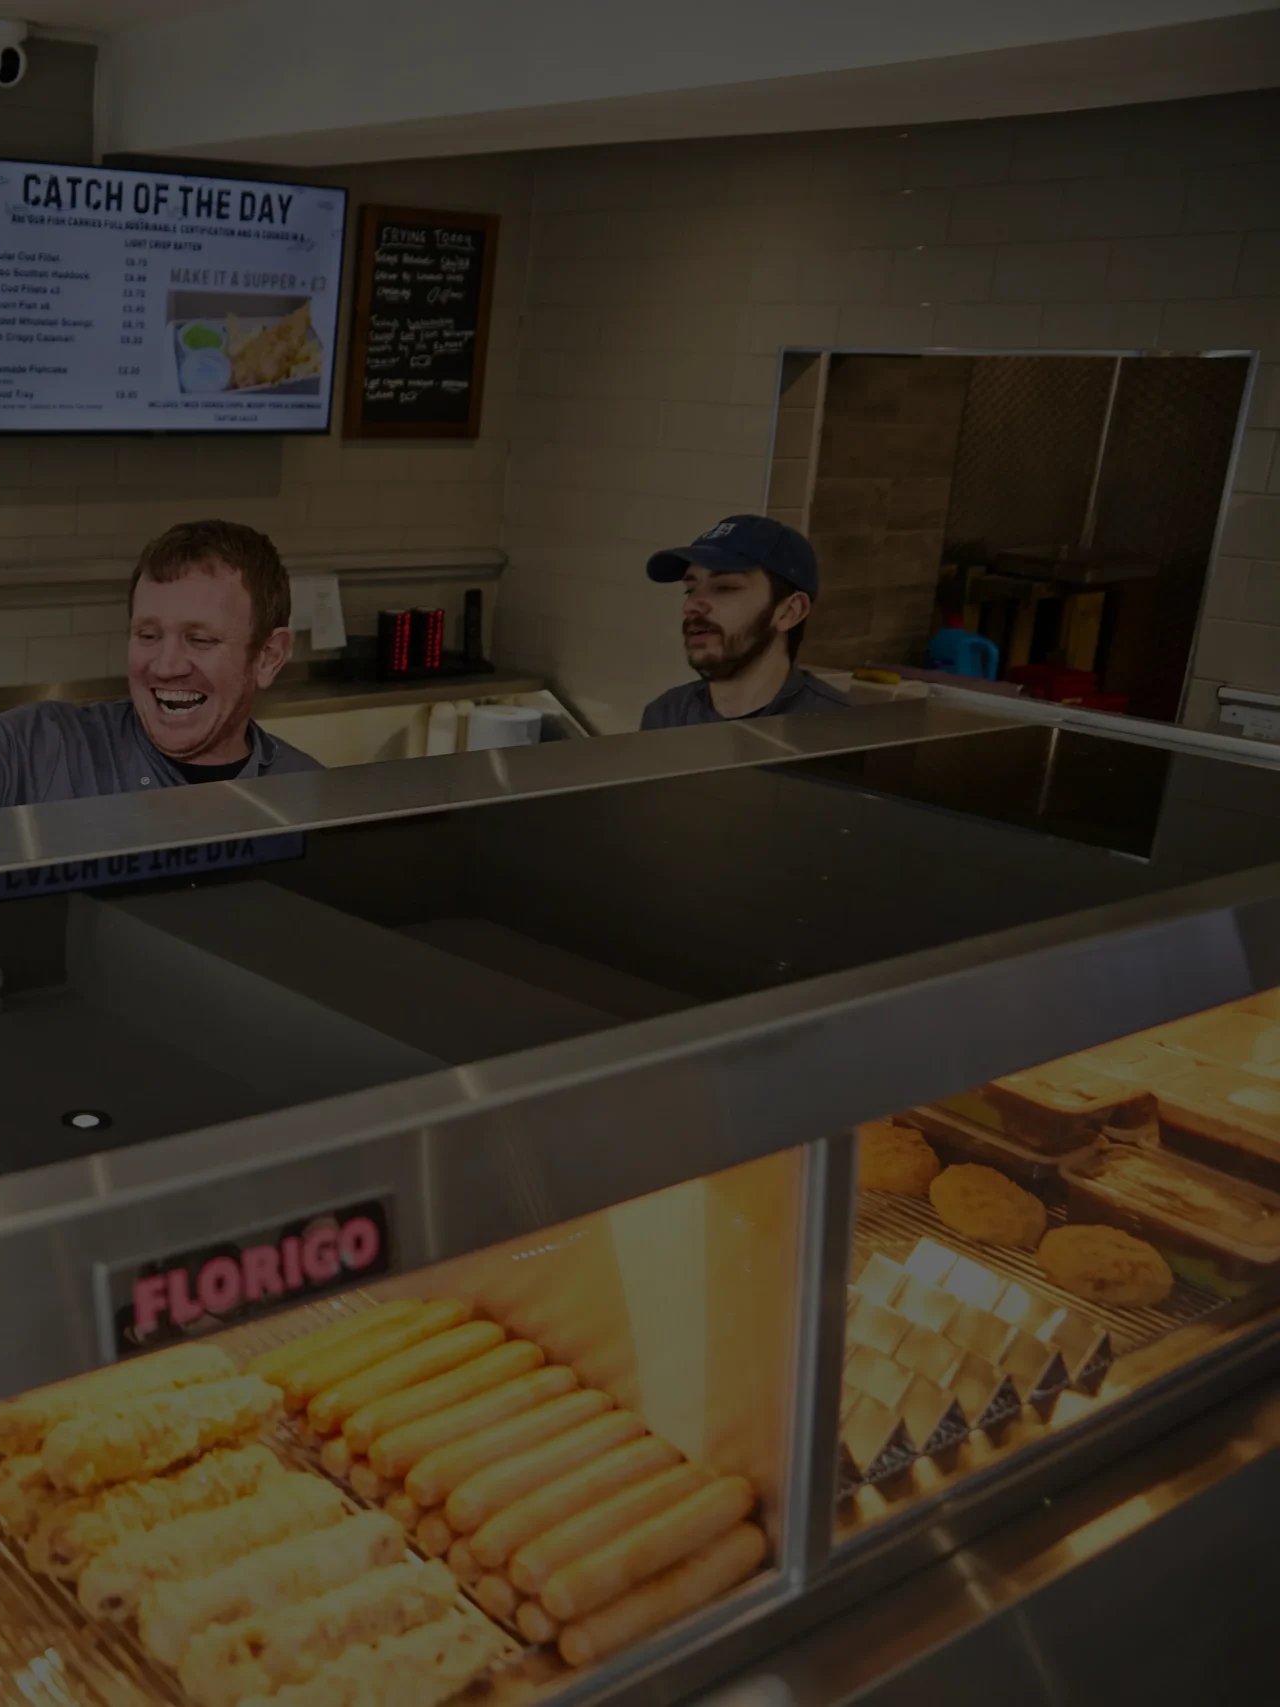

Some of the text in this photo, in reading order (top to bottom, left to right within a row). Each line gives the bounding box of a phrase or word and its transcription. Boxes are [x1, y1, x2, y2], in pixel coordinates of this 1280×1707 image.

[23, 173, 293, 226] CATCH OF THE DAY
[170, 267, 211, 286] MAKE
[213, 269, 225, 287] IT
[230, 270, 239, 287] A
[243, 270, 298, 291] SUPPER
[131, 1215, 381, 1335] FLORIGO
